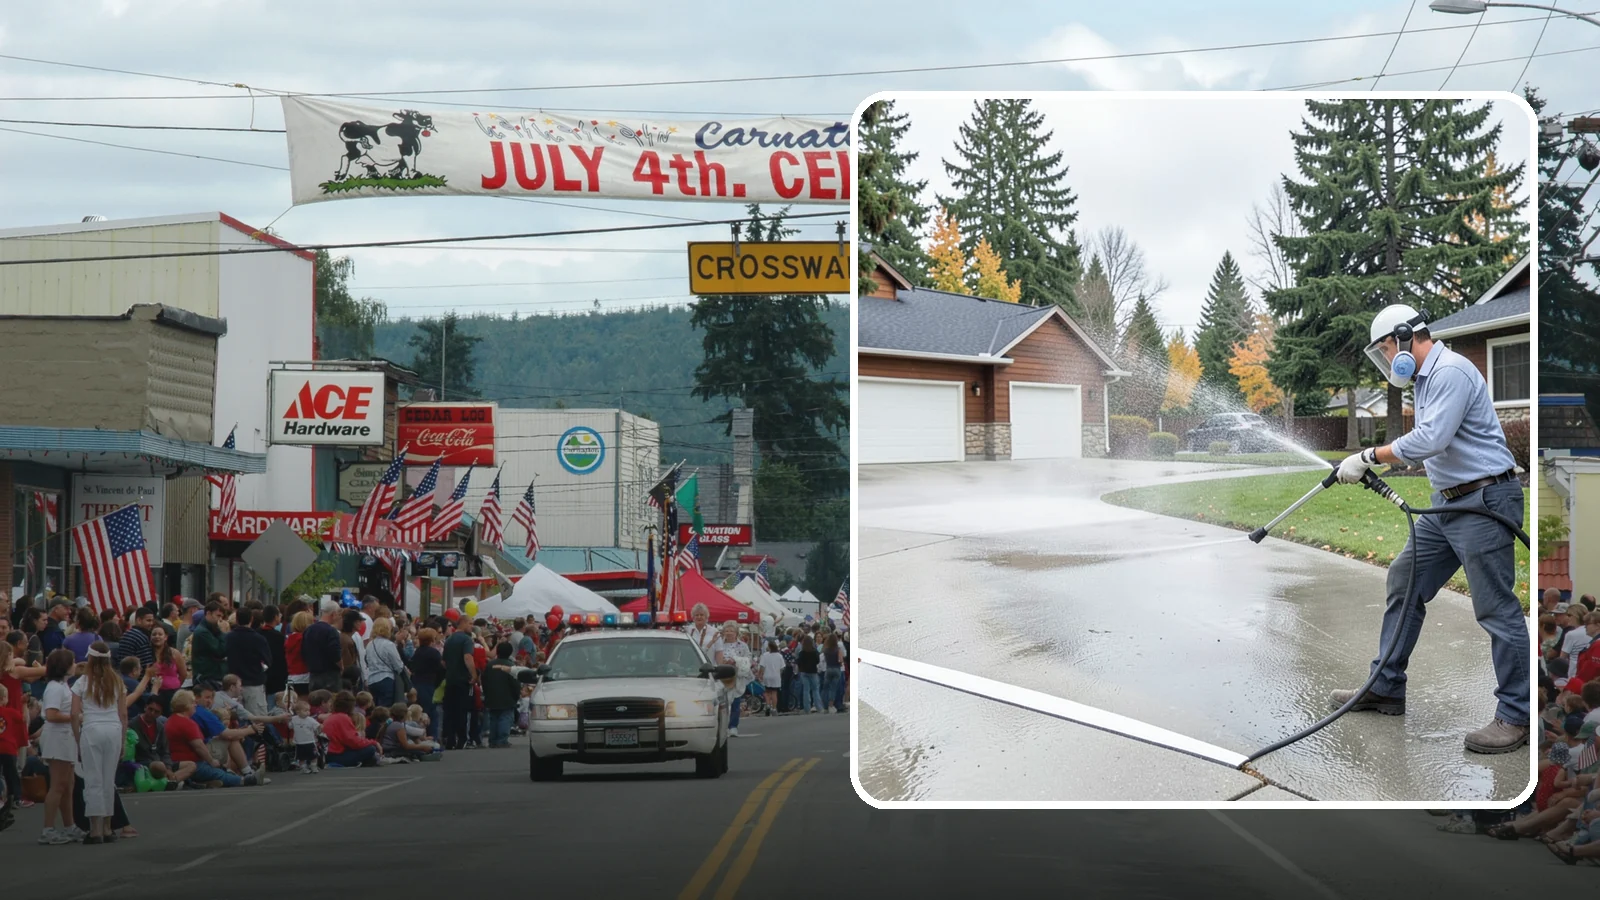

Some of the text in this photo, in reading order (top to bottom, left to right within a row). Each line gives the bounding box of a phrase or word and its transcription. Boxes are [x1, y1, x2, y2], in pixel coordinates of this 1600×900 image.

[695, 121, 850, 149] Carnat
[481, 141, 604, 192] JULY
[632, 150, 746, 198] 4th.
[697, 254, 850, 280] CROSSWA
[283, 380, 373, 420] ACE
[405, 410, 452, 422] CEDAR
[283, 421, 370, 437] Hardware
[416, 428, 477, 447] Coca-Cola
[354, 467, 384, 481] Simpl
[95, 485, 124, 495] Vincent
[126, 485, 136, 495] de
[137, 486, 155, 496] Paul
[80, 503, 154, 522] THT
[212, 516, 331, 536] HARDARE
[688, 526, 741, 535] CRNATION
